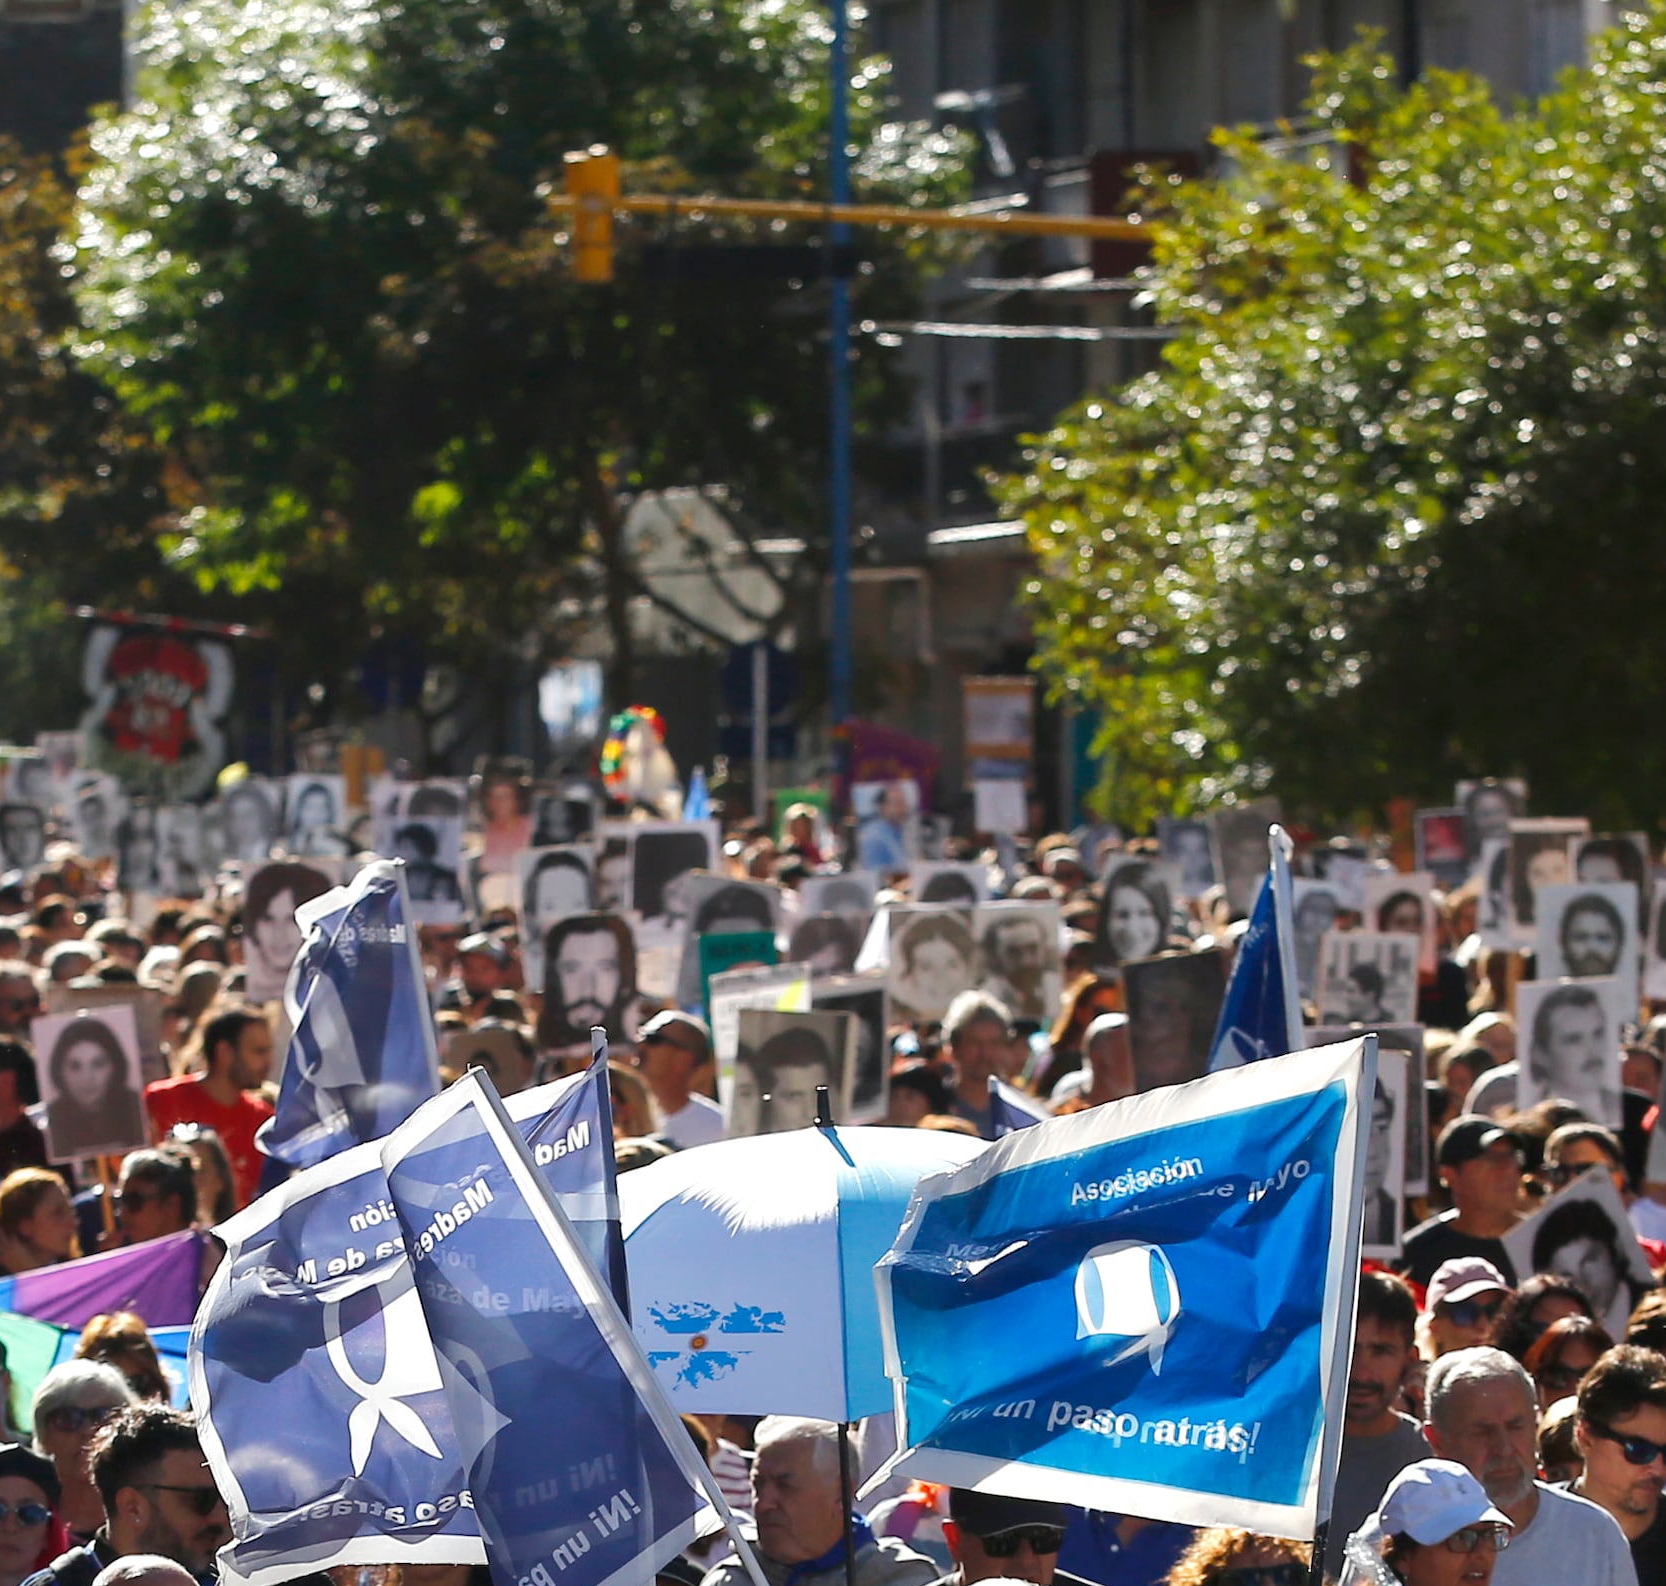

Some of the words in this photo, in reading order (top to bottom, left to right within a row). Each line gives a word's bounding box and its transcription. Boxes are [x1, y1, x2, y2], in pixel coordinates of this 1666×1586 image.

[1070, 1156, 1204, 1208] Asociación
[991, 1398, 1036, 1420] un
[1047, 1400, 1139, 1440] paso
